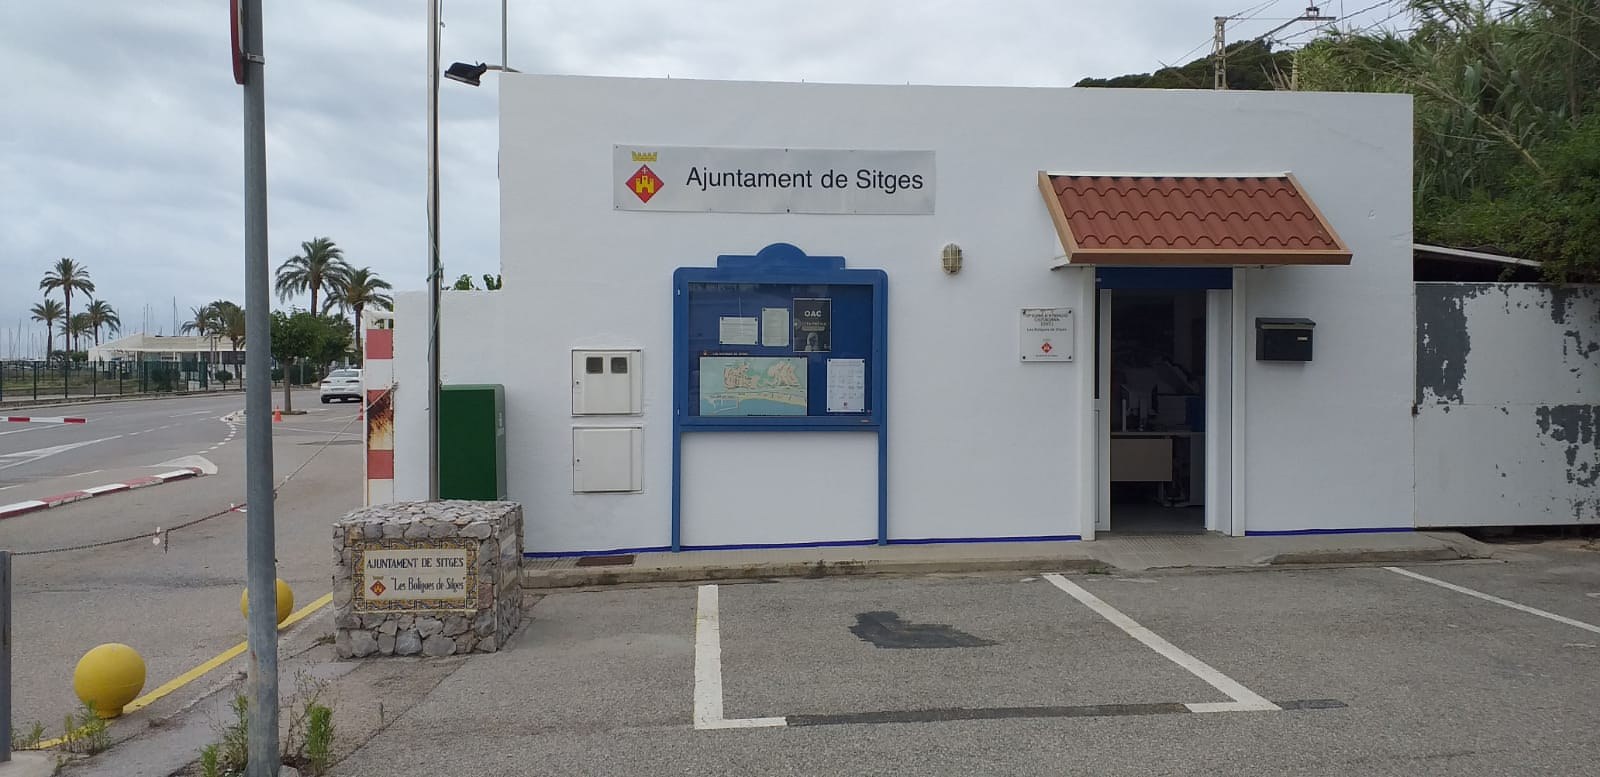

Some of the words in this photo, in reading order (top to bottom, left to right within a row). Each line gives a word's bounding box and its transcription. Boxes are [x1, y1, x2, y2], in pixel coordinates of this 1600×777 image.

[686, 166, 813, 192] Ajuntament
[820, 169, 848, 190] de
[856, 169, 924, 194] Sitges
[804, 310, 822, 318] OAC
[367, 557, 418, 569] AJUNTAMENT
[421, 557, 432, 568] DE
[435, 557, 464, 568] SITGES
[435, 577, 445, 591] de
